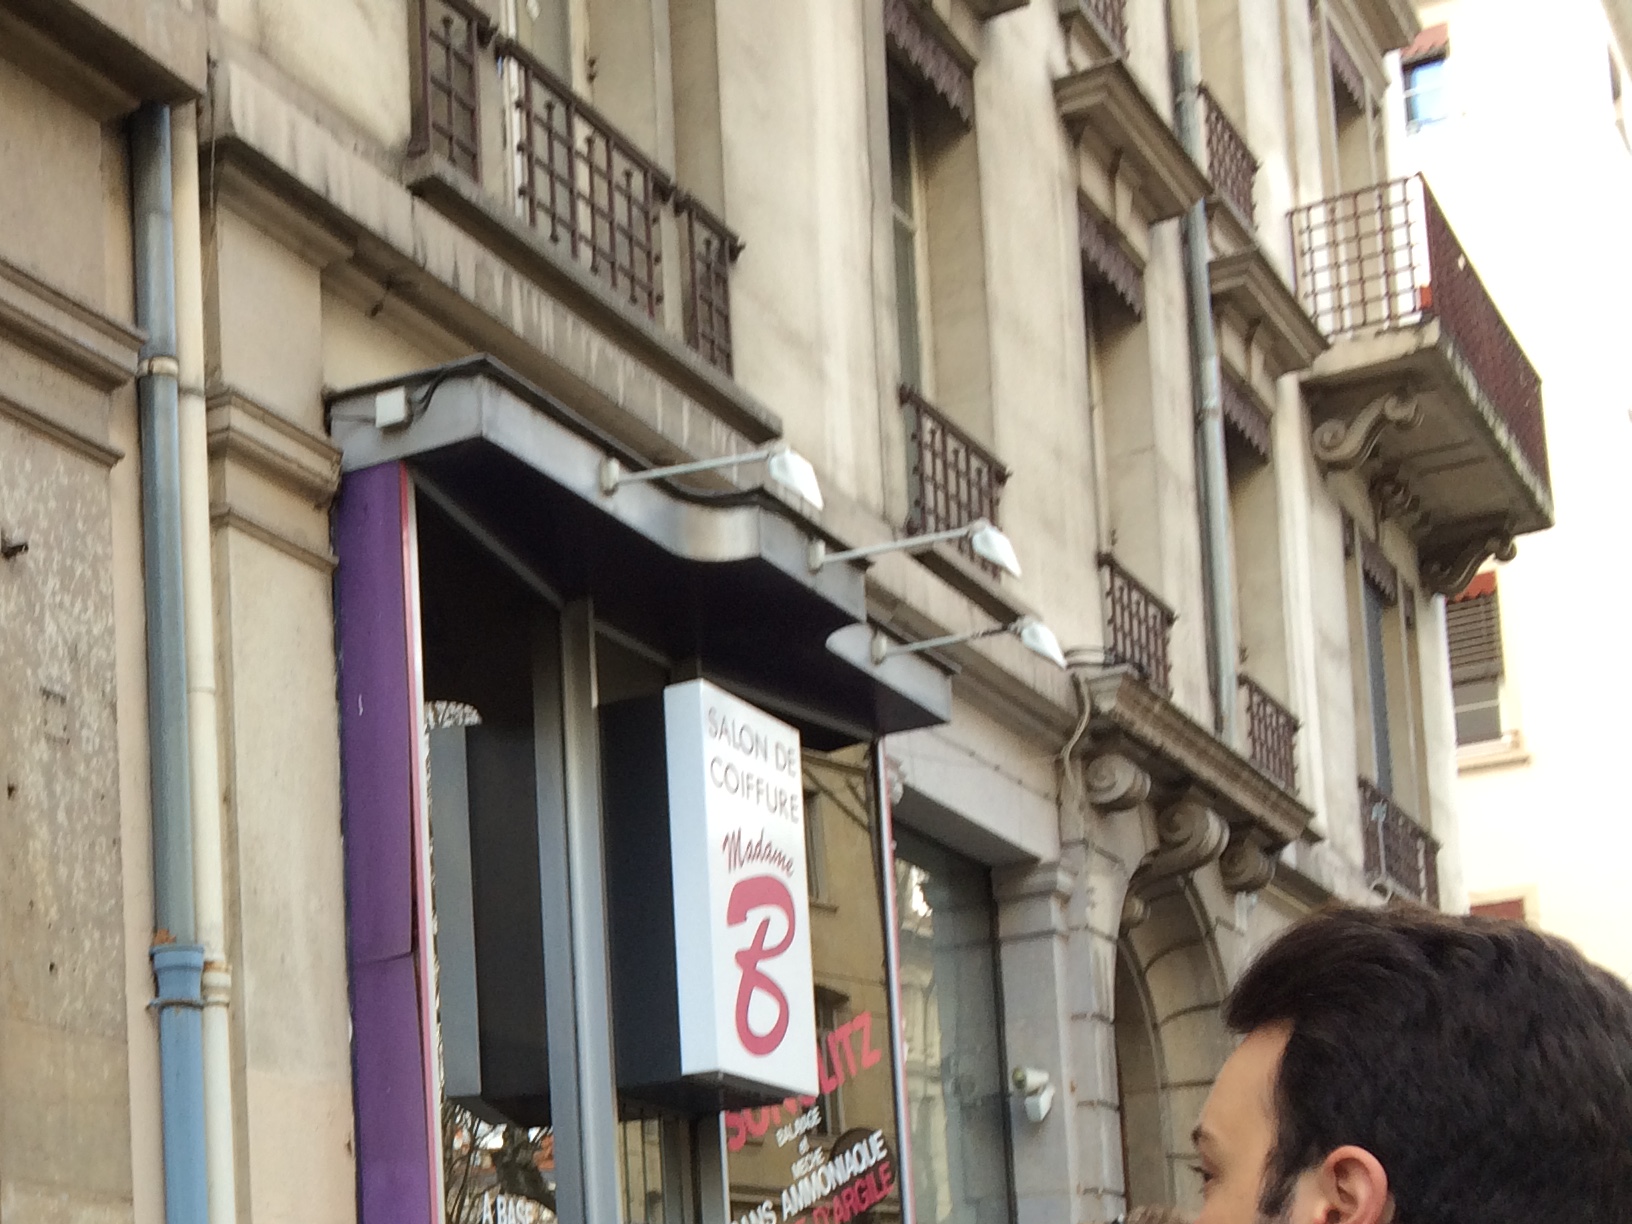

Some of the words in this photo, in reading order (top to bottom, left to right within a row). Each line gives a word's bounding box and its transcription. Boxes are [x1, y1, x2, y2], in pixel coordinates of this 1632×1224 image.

[708, 706, 768, 762] SALON
[774, 741, 797, 778] DE
[709, 755, 800, 824] COIFFURE
[722, 826, 795, 878] Madame
[725, 1010, 883, 1153] SULITZ
[780, 1128, 888, 1222] AMMONIAQUE
